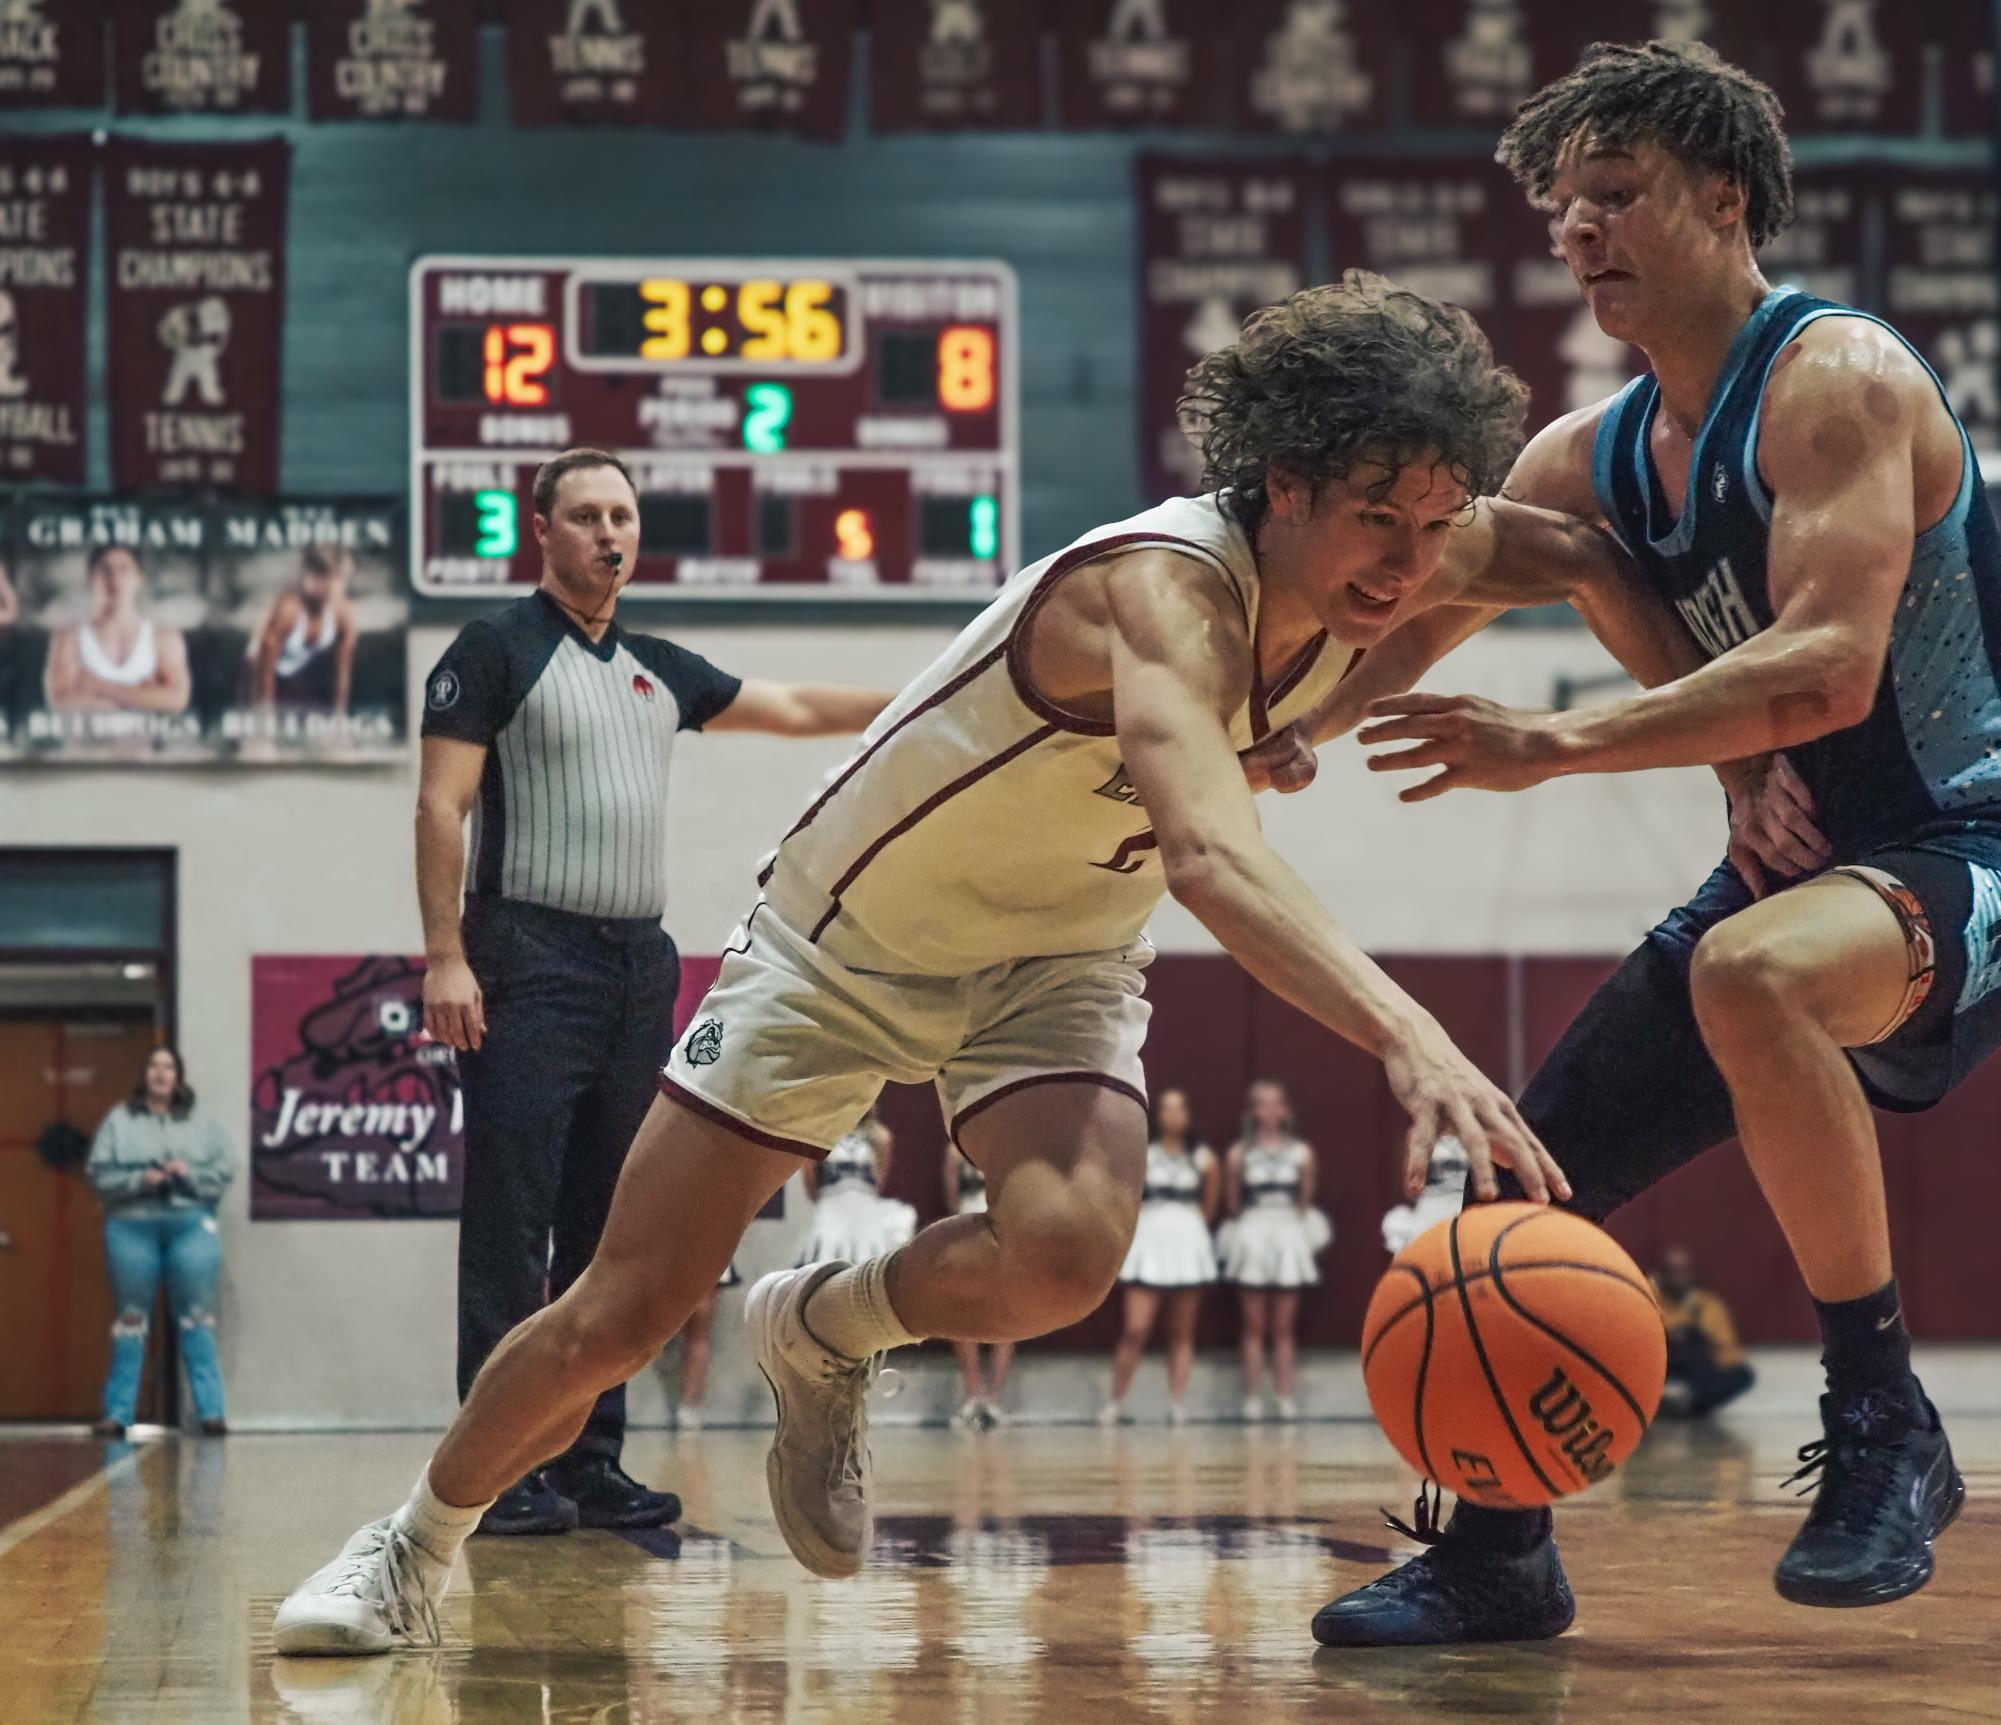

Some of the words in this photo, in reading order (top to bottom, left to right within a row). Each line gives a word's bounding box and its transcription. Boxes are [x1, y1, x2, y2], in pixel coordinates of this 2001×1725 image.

[151, 204, 242, 243] STATE
[117, 249, 272, 289] CHAMPIONS
[440, 275, 546, 316] HOME
[638, 277, 842, 362] 3:56
[484, 323, 556, 405] 12
[937, 324, 996, 414] 8
[144, 413, 243, 451] TENNIS
[743, 382, 792, 454] 2
[27, 517, 202, 547] GRAHAM
[224, 517, 391, 547] MADDEN
[474, 490, 518, 559] 3
[262, 1087, 436, 1152] Jeremy
[322, 1152, 448, 1183] TEAM
